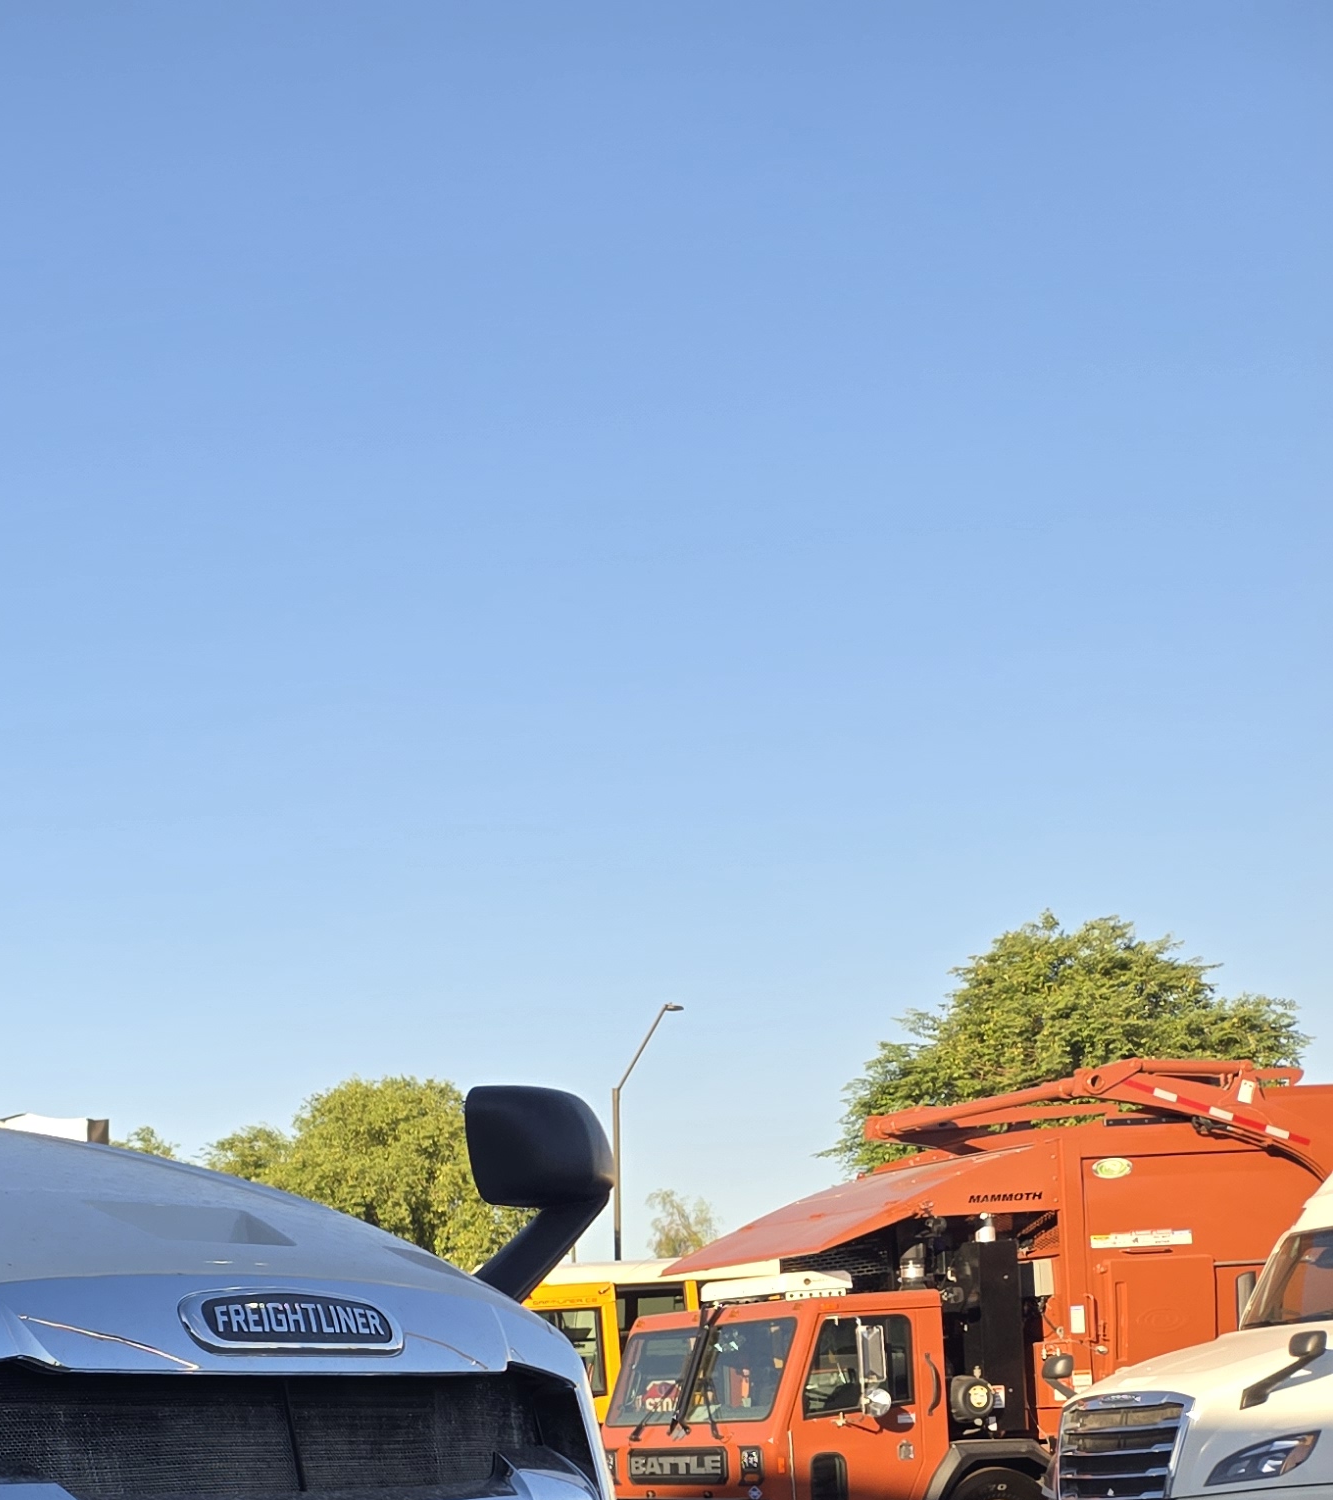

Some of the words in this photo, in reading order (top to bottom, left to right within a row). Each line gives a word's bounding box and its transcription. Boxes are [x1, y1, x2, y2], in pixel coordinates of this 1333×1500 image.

[968, 1191, 1043, 1203] MAMMOTH
[214, 1302, 385, 1336] FREIGHTLINER
[631, 1455, 722, 1475] BATTLE
